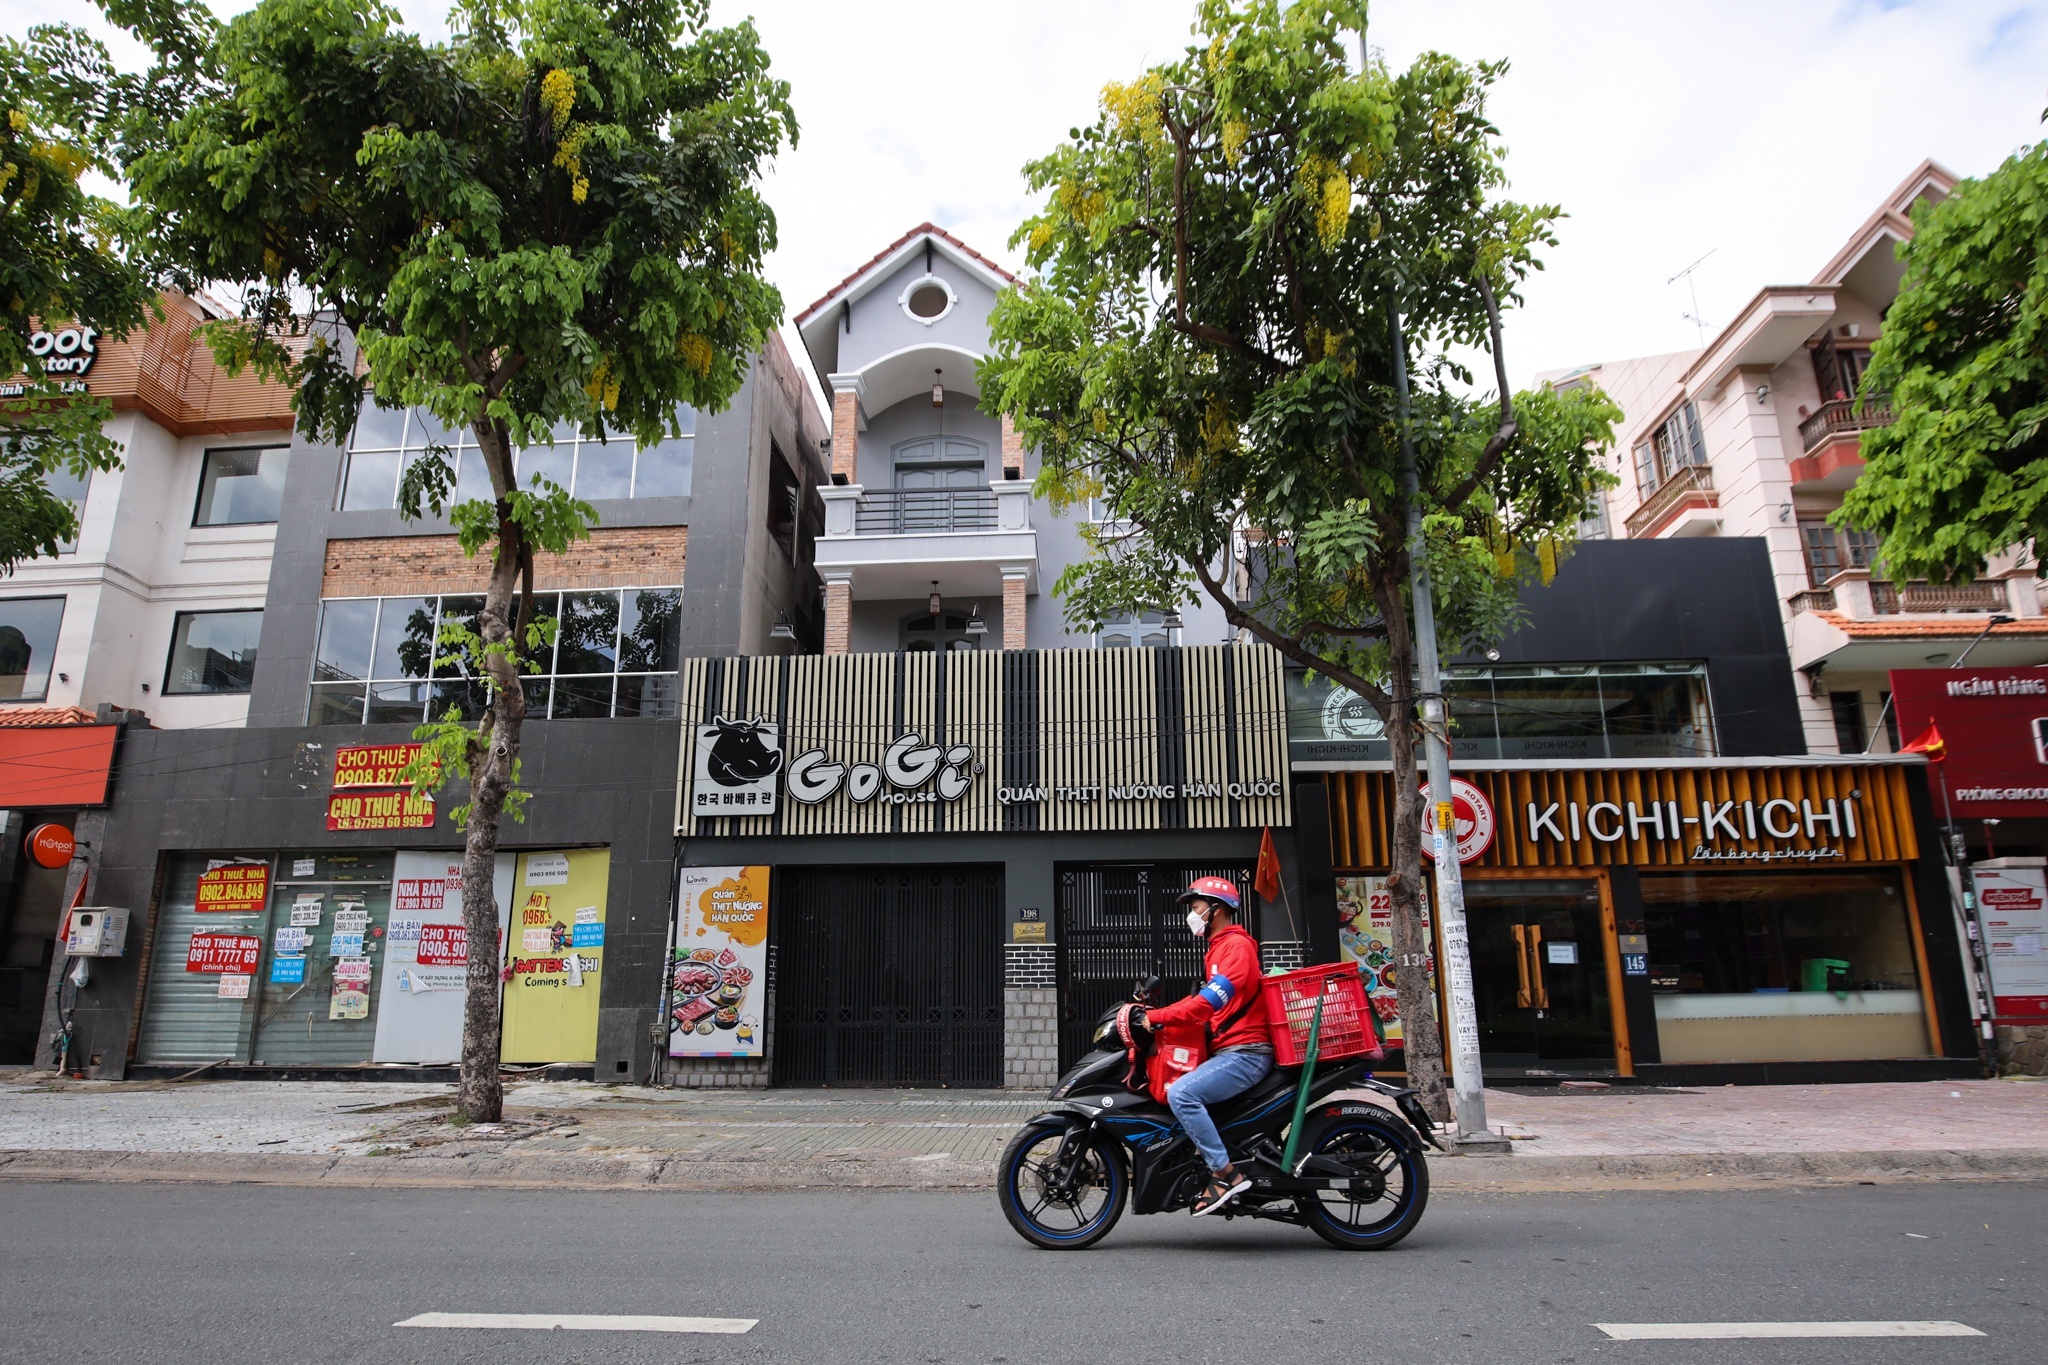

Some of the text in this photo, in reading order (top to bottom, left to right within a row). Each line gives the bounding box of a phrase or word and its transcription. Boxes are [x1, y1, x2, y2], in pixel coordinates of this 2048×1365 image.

[40, 357, 92, 374] tory
[1946, 675, 2047, 696] NGÂN HÀNG
[337, 746, 407, 767] CHO THUÊ
[335, 769, 374, 785] 0908
[697, 792, 772, 806] 한국 바베큐 관
[880, 786, 938, 805] house
[996, 777, 1281, 805] QUÁN THỊT NƯỚNG HÀN QUỐC
[1955, 785, 2002, 801] PHÒNG
[330, 792, 401, 818] CHO THUÊ
[1464, 790, 1488, 821] ROTARY
[354, 818, 384, 828] 07799
[387, 817, 401, 827] 60
[402, 816, 423, 827] 999
[1527, 797, 1857, 842] KICHI-KICHI
[40, 838, 73, 852] Hotpot
[1457, 844, 1473, 855] OT
[223, 870, 245, 880] THUÊ
[247, 868, 266, 879] NHÀ
[199, 883, 265, 901] 0902.846.849
[398, 880, 444, 896] NHÀ BÁN
[527, 894, 541, 907] HO
[711, 902, 732, 913] THỊT
[711, 911, 754, 923] HÀN QUỐC
[1021, 908, 1037, 918] 198
[191, 936, 259, 949] CHO THUÊ NHÀ
[422, 928, 467, 941] CHO THU
[190, 948, 257, 964] 0911 7777 69
[420, 941, 467, 958] 0906.90
[201, 963, 224, 973] (chính
[515, 957, 599, 974] GATTENSSHI
[1626, 956, 1645, 970] 145
[525, 977, 559, 988] Coming
